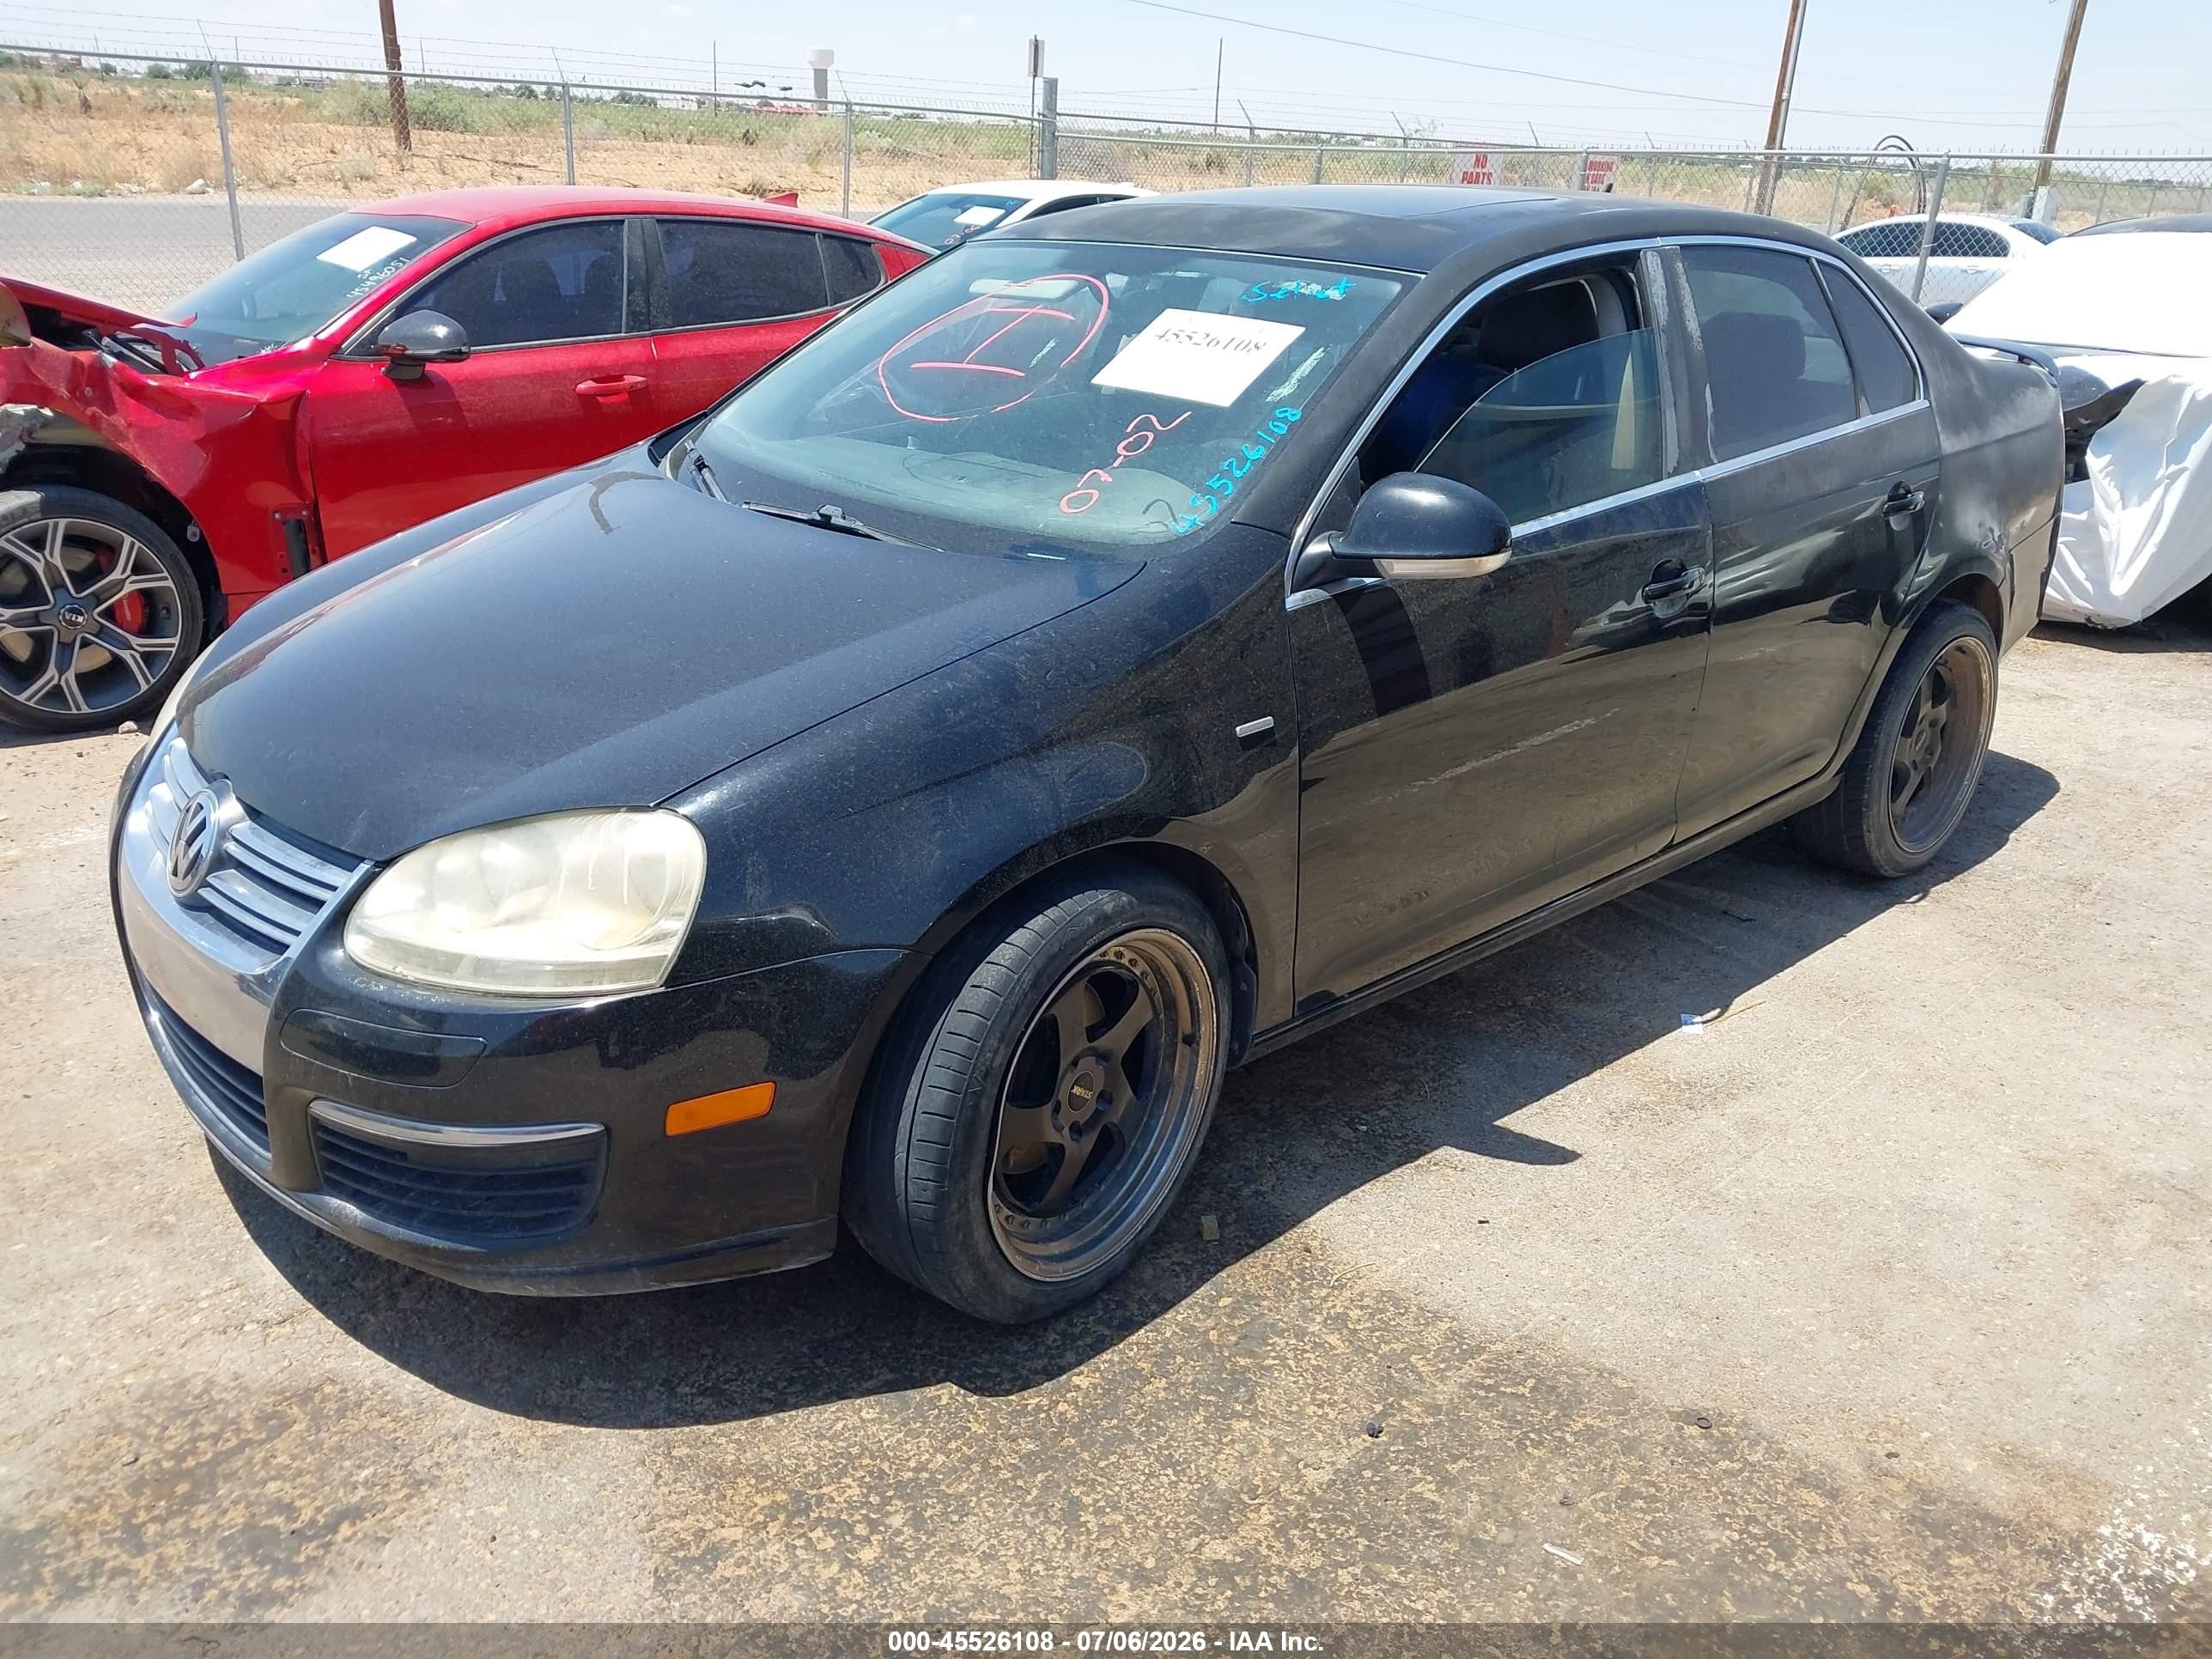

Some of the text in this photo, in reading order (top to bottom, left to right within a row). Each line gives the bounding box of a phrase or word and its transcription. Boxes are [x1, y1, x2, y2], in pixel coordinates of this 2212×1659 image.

[1473, 153, 1488, 169] NO
[1461, 170, 1492, 185] PARTS
[345, 257, 410, 298] 45496051
[1154, 328, 1267, 354] 45526108
[1170, 406, 1304, 536] 45526108
